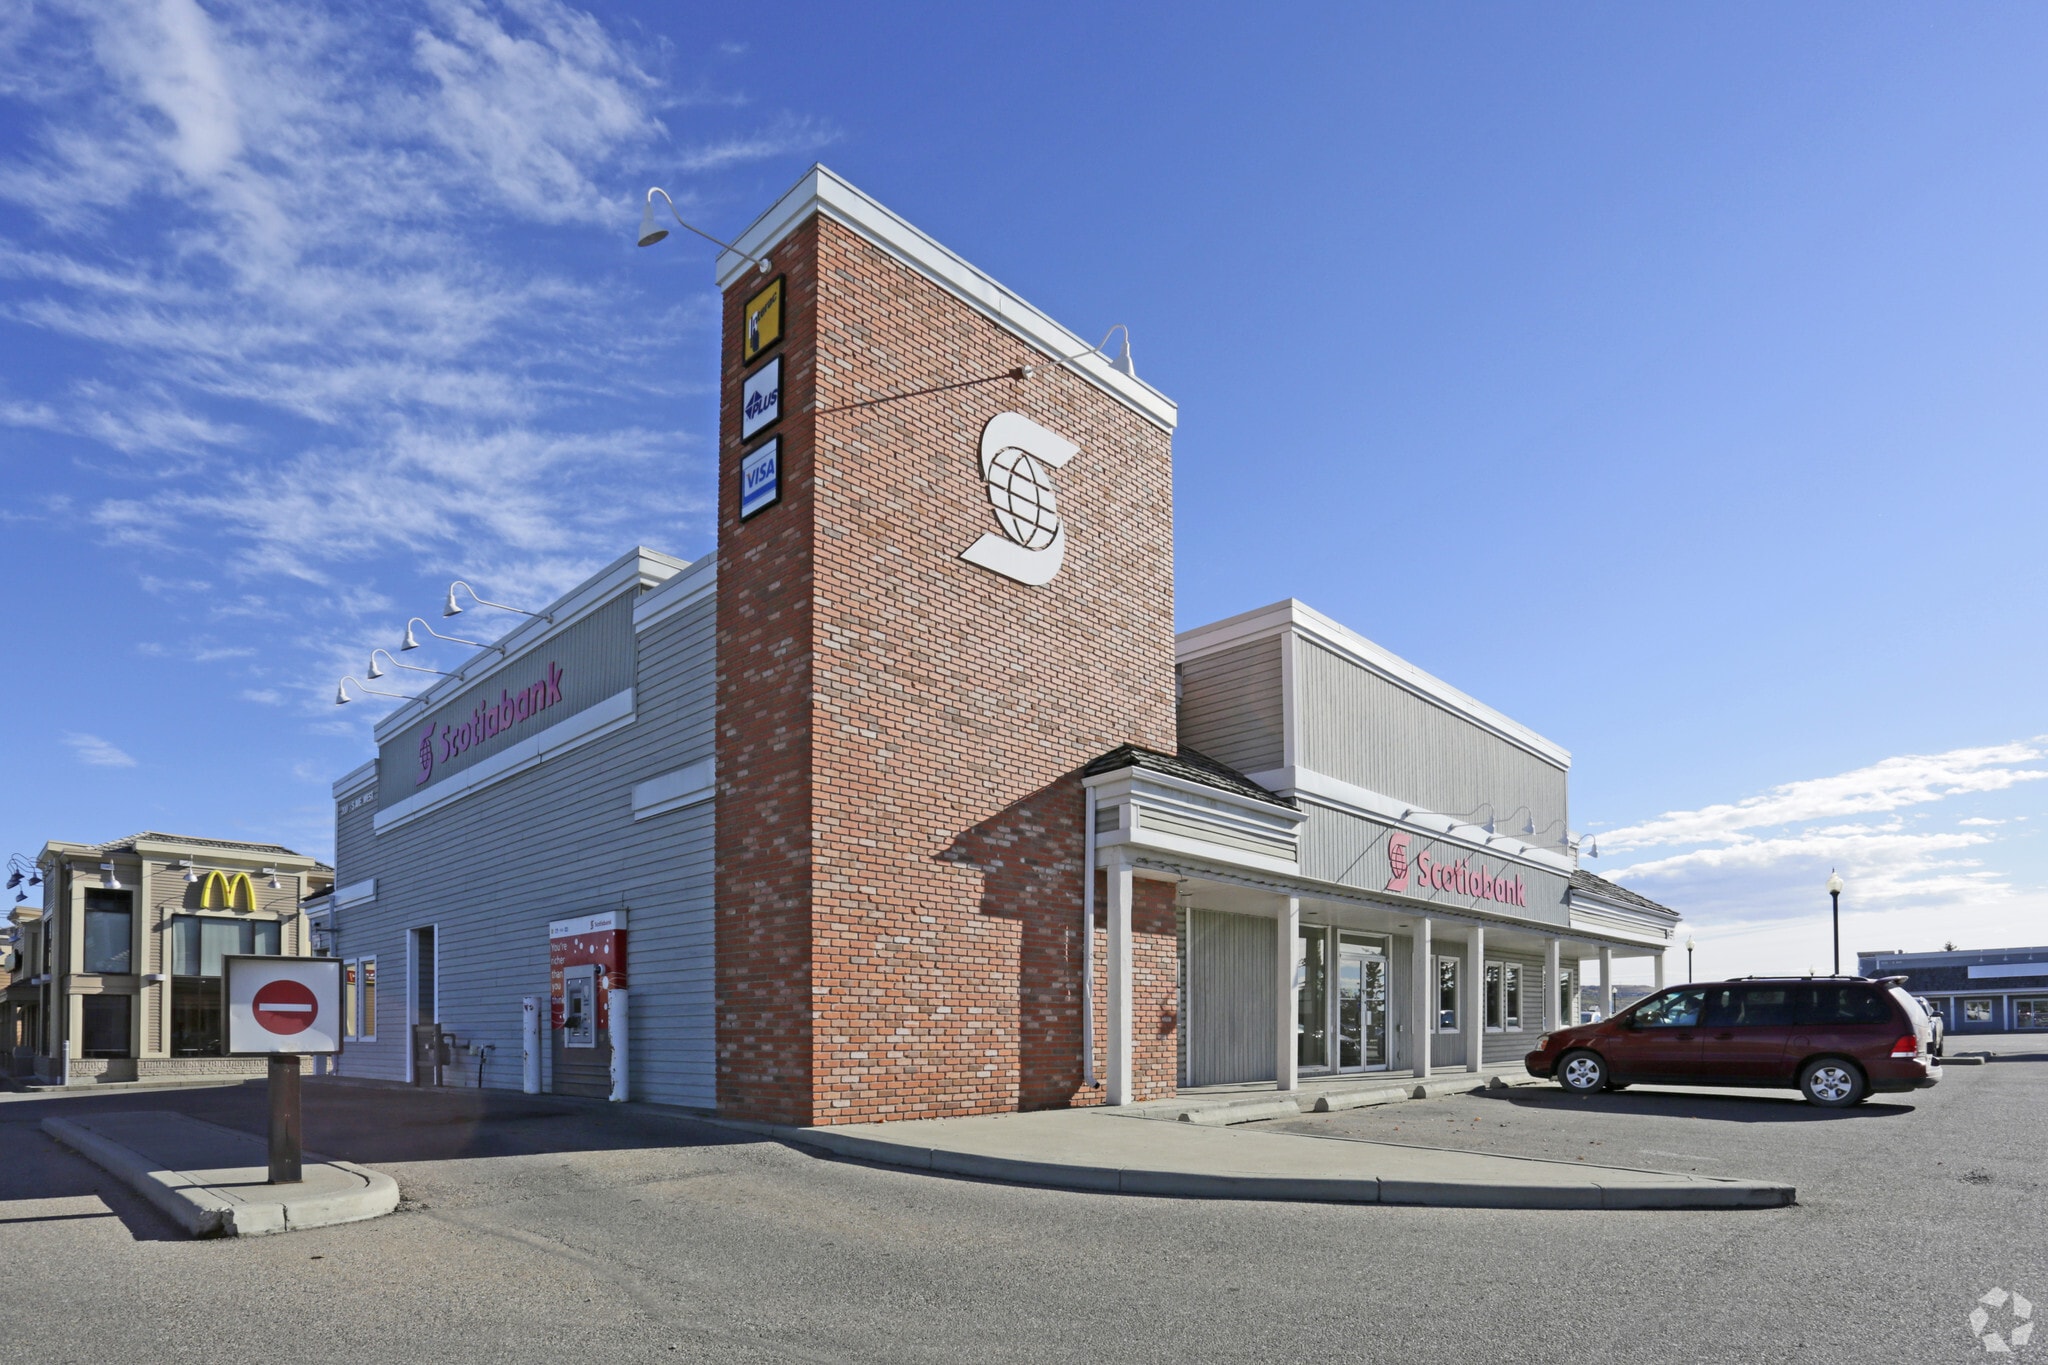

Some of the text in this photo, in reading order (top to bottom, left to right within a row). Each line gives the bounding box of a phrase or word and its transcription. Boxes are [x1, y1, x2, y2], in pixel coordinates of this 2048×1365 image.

[751, 388, 778, 420] PLUS
[746, 458, 775, 489] VISA
[439, 661, 563, 764] Scotiabank
[1417, 851, 1527, 907] Scotiabank
[552, 983, 562, 993] you
